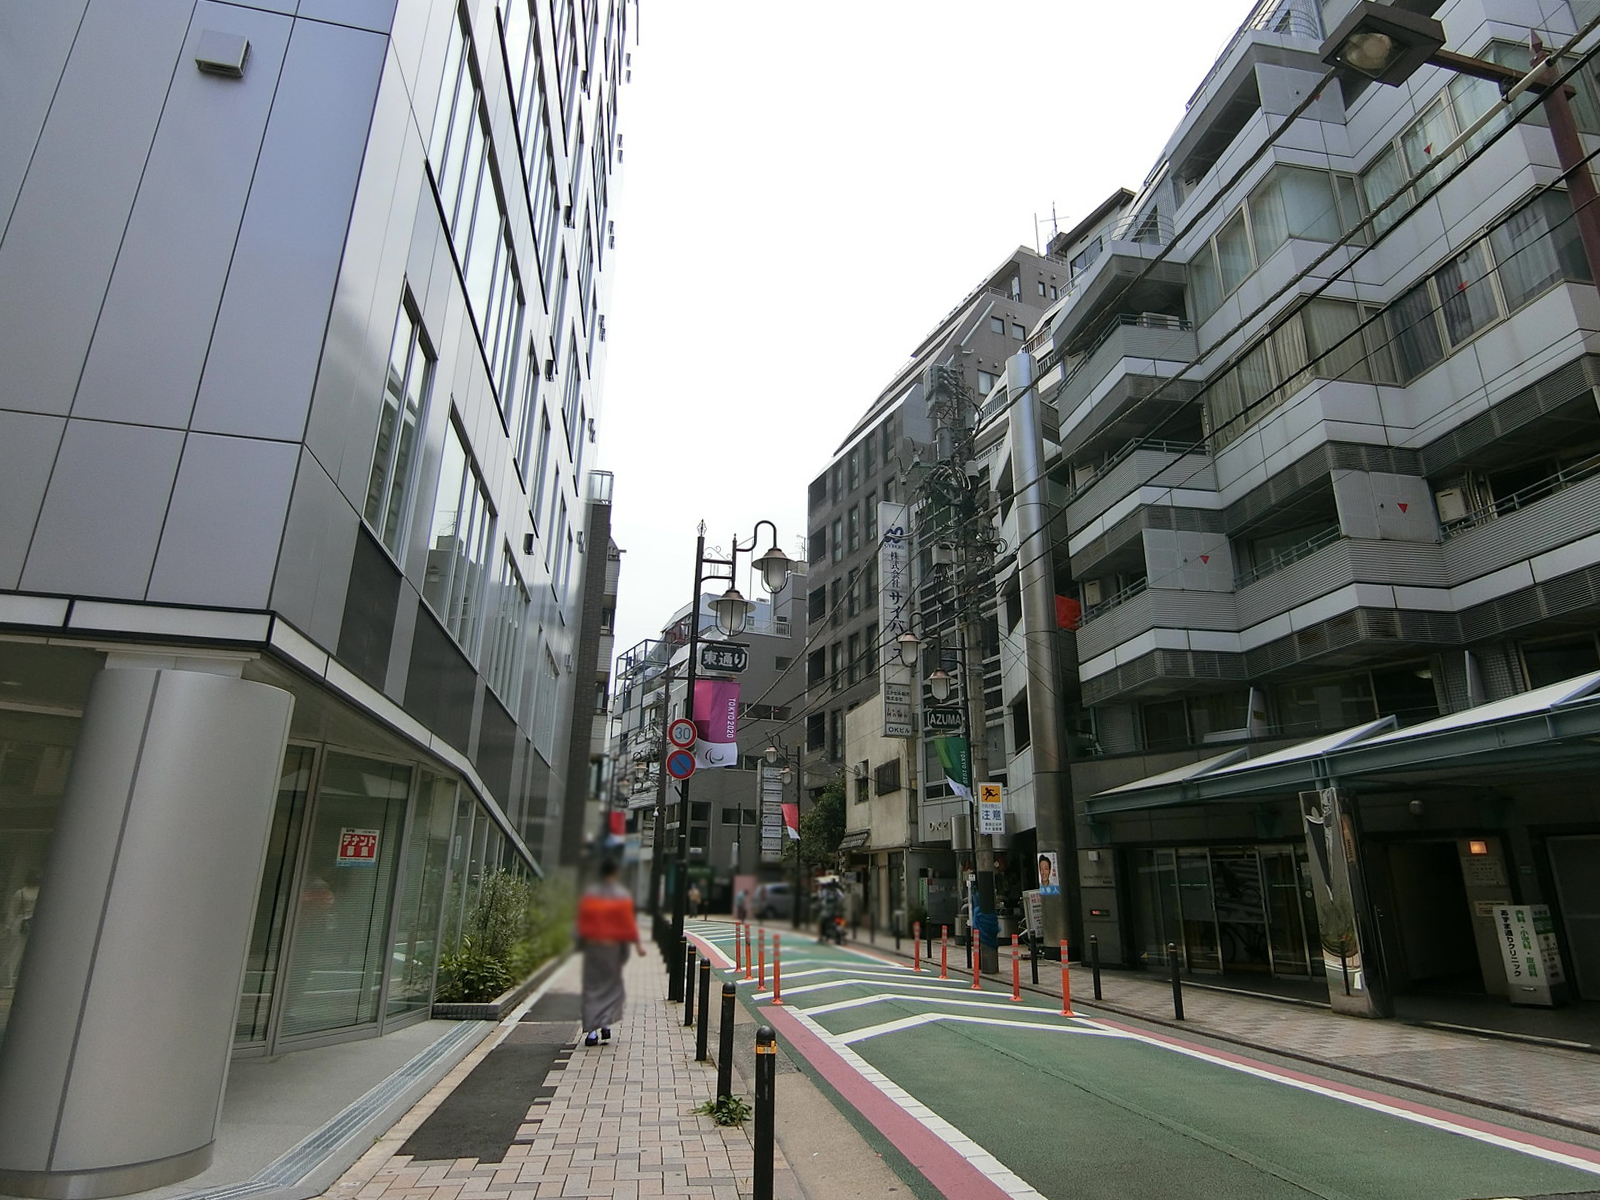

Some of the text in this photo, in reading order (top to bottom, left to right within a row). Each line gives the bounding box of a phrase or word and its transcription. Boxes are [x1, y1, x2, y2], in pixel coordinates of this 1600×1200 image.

[702, 650, 745, 668] 東通り
[726, 698, 736, 739] TOKYO 2020
[929, 713, 962, 725] AZUMA
[674, 726, 691, 740] 30
[960, 750, 968, 769] TOKYO
[981, 809, 1002, 821] 注意
[343, 835, 375, 847] テナント
[1500, 909, 1521, 977] あずま通りクリニック
